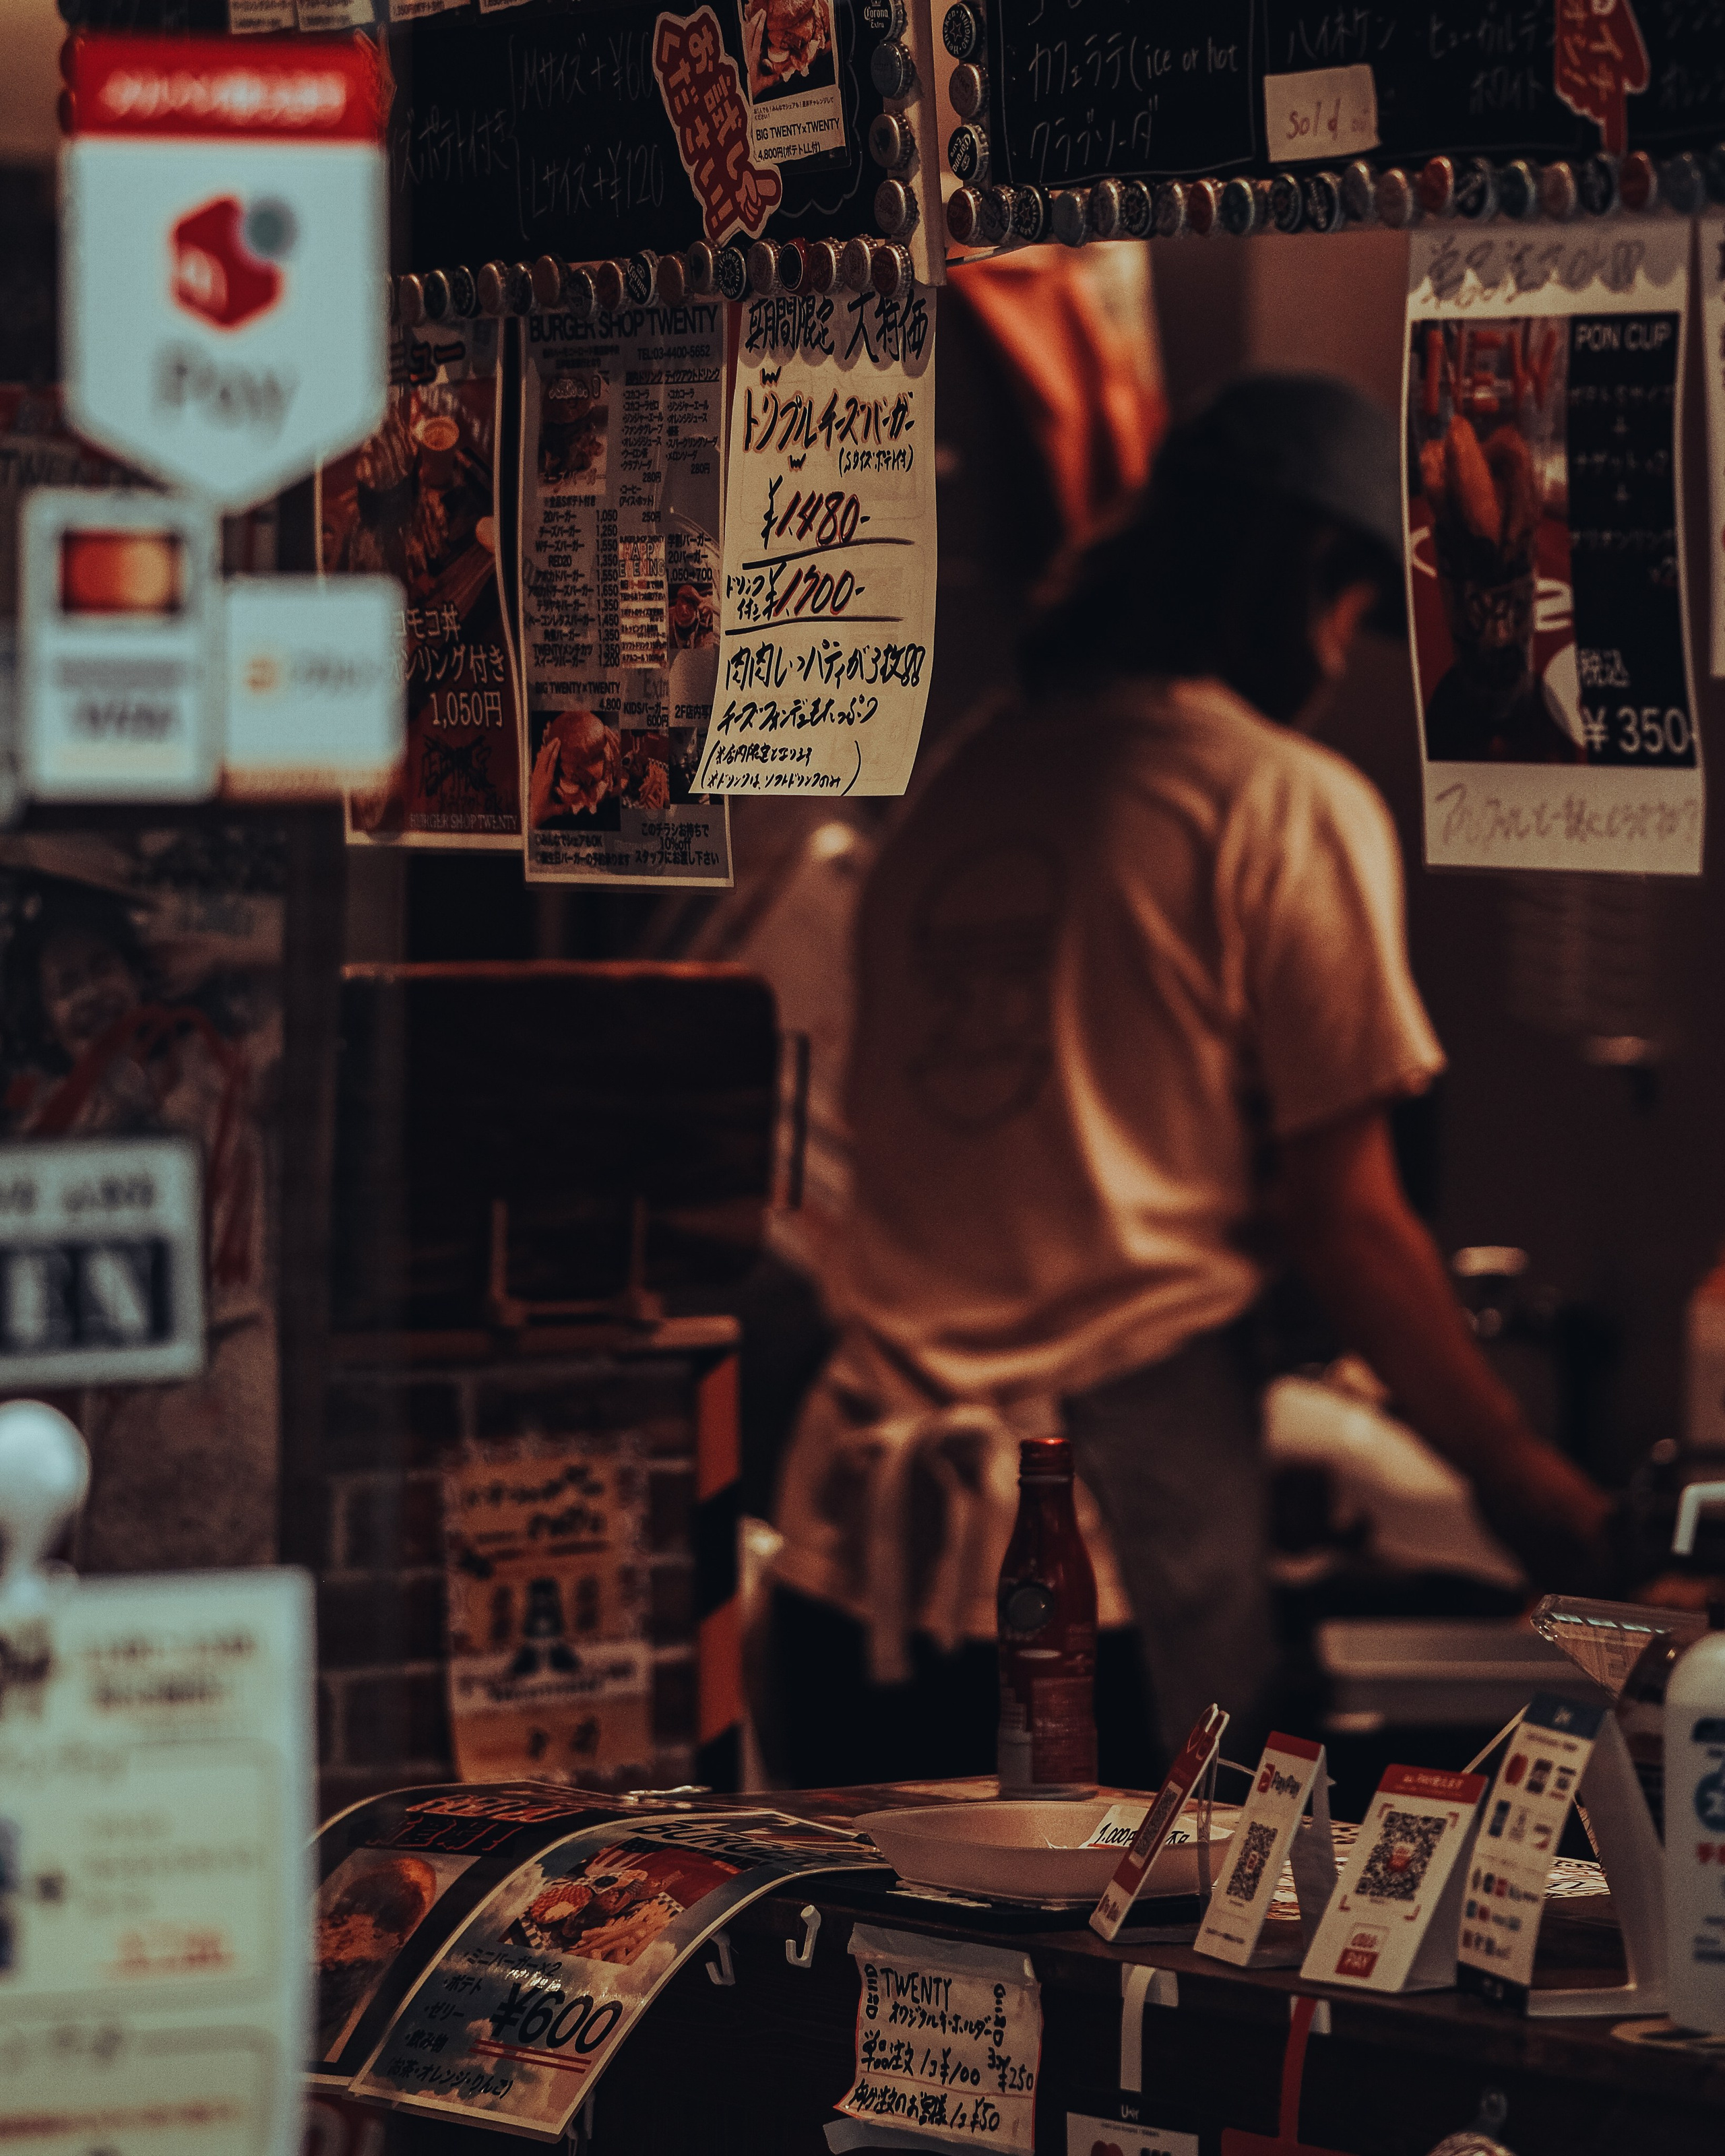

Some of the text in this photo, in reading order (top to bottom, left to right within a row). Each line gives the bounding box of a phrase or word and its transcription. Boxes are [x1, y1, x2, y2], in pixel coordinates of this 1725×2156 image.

[864, 5, 889, 20] Corona
[871, 18, 884, 28] Extra
[1183, 48, 1198, 71] or
[1208, 36, 1238, 74] hot
[689, 25, 743, 180] お試し
[756, 127, 768, 141] BIG
[952, 133, 971, 172] Corona
[627, 261, 648, 297] Corona
[600, 311, 644, 338] SHOP
[647, 305, 718, 337] TWENTY
[1624, 321, 1673, 352] CUP
[743, 388, 914, 451] トリプルチーズバーガー
[691, 463, 710, 474] 280円
[643, 472, 661, 482] 280円
[596, 509, 617, 523] 1,050
[641, 511, 661, 523] 250円
[539, 524, 617, 538] チーズバーガー 1,250
[596, 539, 618, 552] 1,550
[623, 542, 661, 560] HAPPY
[596, 554, 618, 568] 1,350
[668, 550, 708, 563] 20バーガー
[596, 569, 618, 583] 1,550
[597, 584, 619, 598] 1,650
[726, 575, 765, 598] ドリンク
[597, 599, 619, 612] 1,350
[598, 614, 619, 627] 1,450
[598, 629, 620, 641] 1,350
[536, 682, 548, 694] BIG
[430, 689, 503, 730] 1,050円
[600, 698, 621, 711] 4,800
[623, 701, 668, 715] KIDSバーガー
[647, 714, 668, 727] 600円
[451, 813, 476, 829] SHOP
[478, 813, 518, 830] TWENTY
[641, 823, 710, 837] このチラシお持ちで
[660, 837, 691, 850] 10%off
[880, 1967, 952, 2011] TWENTY
[489, 1984, 623, 2056] ¥600
